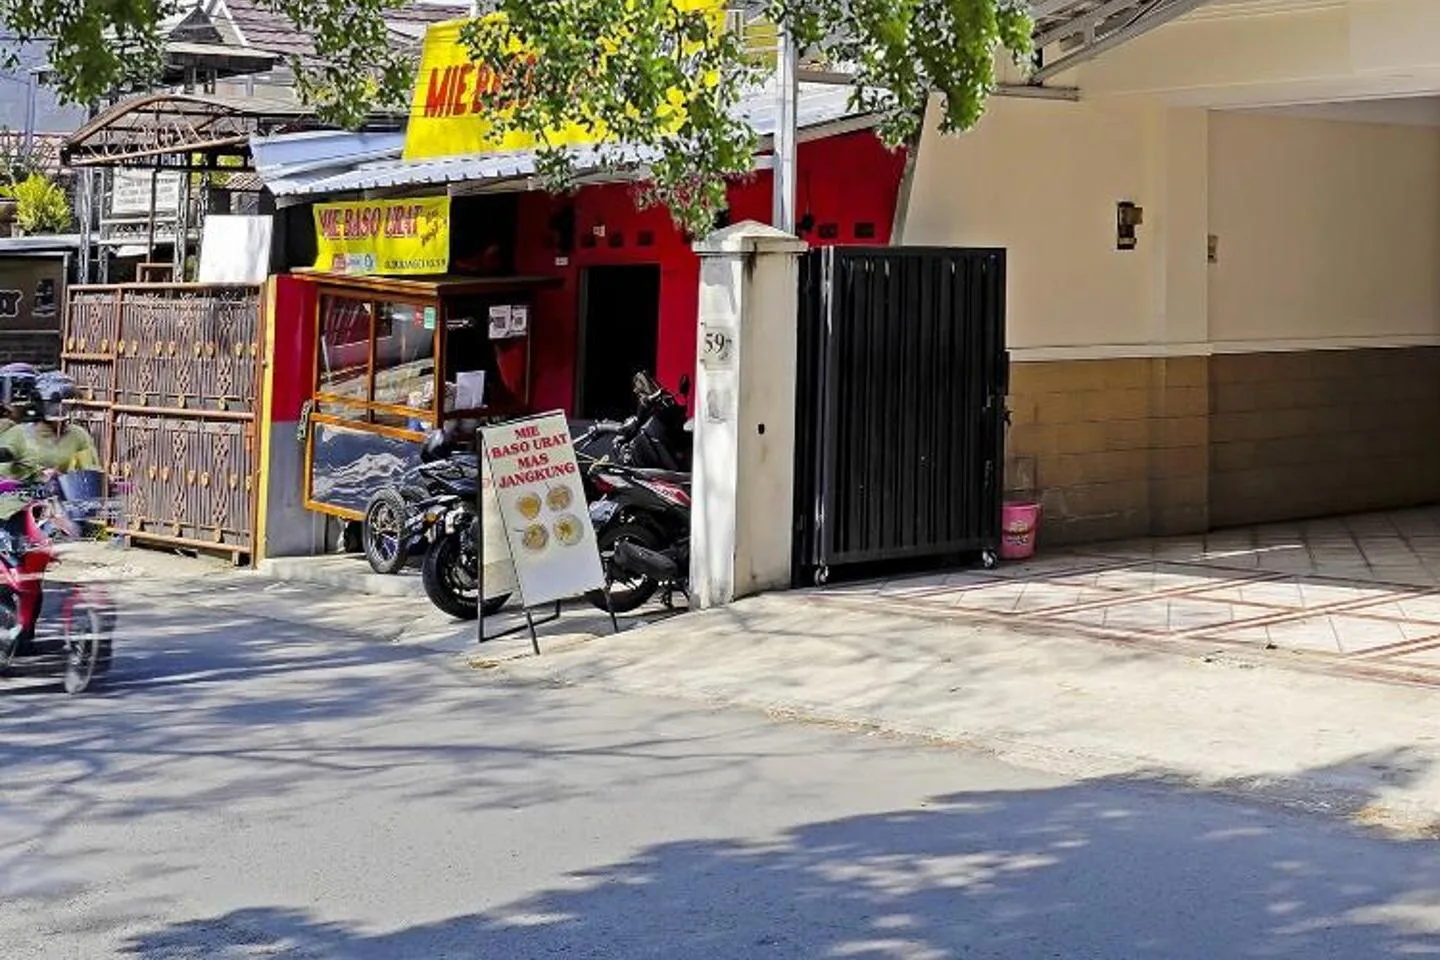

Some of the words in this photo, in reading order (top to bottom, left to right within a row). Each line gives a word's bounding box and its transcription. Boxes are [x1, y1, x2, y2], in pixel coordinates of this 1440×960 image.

[424, 63, 473, 117] MIE
[514, 425, 540, 439] MIE
[491, 441, 530, 458] BASO
[533, 433, 568, 450] URAT
[518, 453, 549, 468] MAS
[499, 462, 576, 488] JANGKUNG
